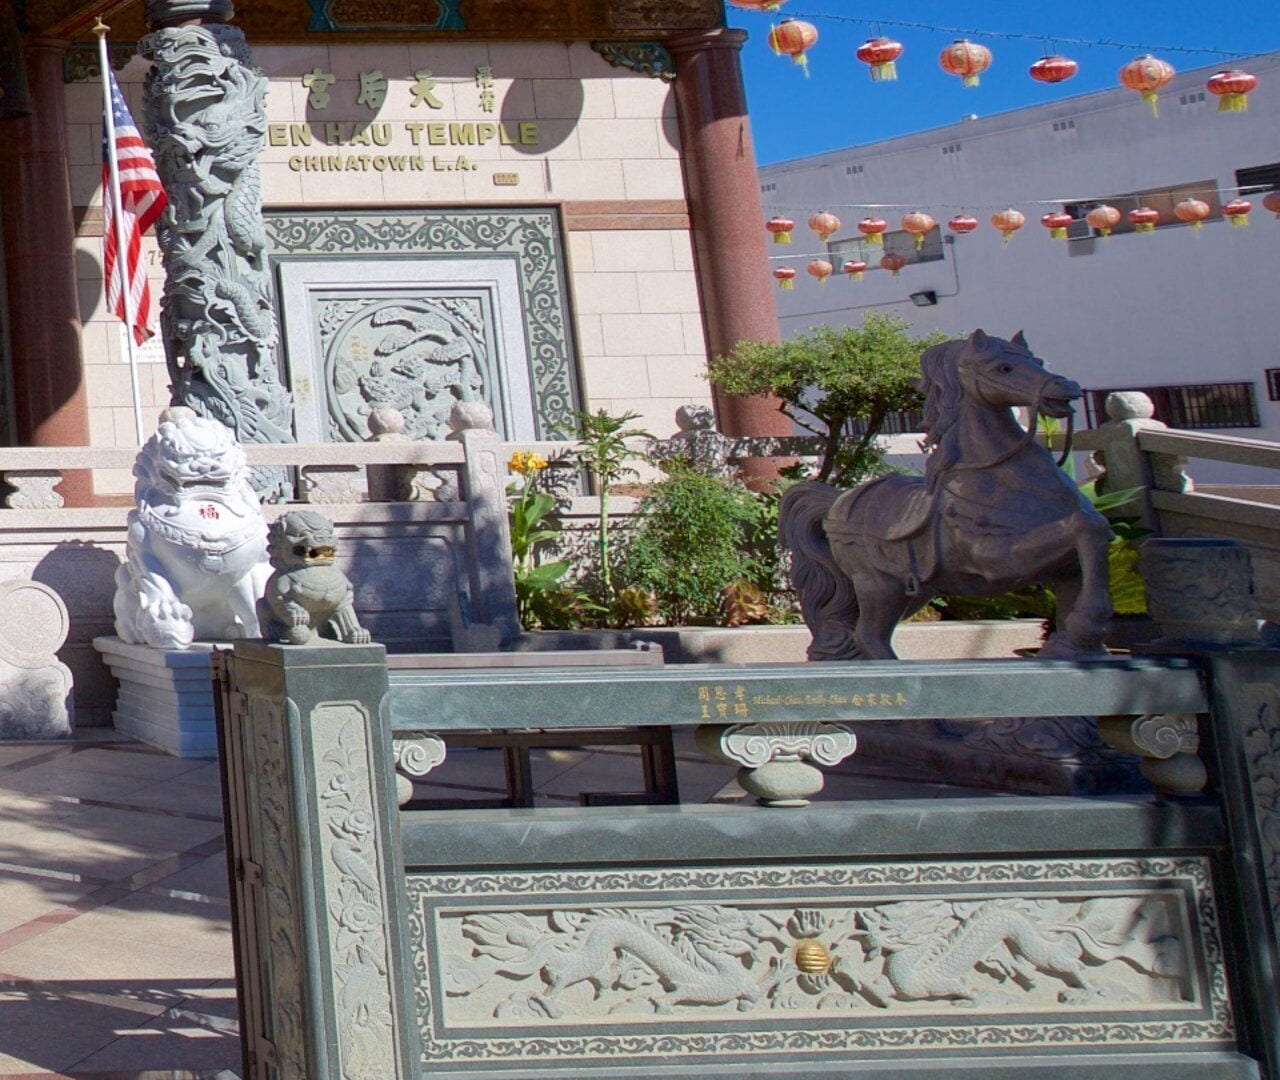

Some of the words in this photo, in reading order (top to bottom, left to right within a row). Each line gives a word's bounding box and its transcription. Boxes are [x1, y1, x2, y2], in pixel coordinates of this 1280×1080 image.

[302, 68, 444, 110] 天后宮
[262, 123, 312, 147] EN
[325, 123, 392, 147] HAU
[406, 122, 538, 147] TEMPLE
[288, 154, 426, 173] CHINATOWN
[433, 154, 478, 173] L.A.
